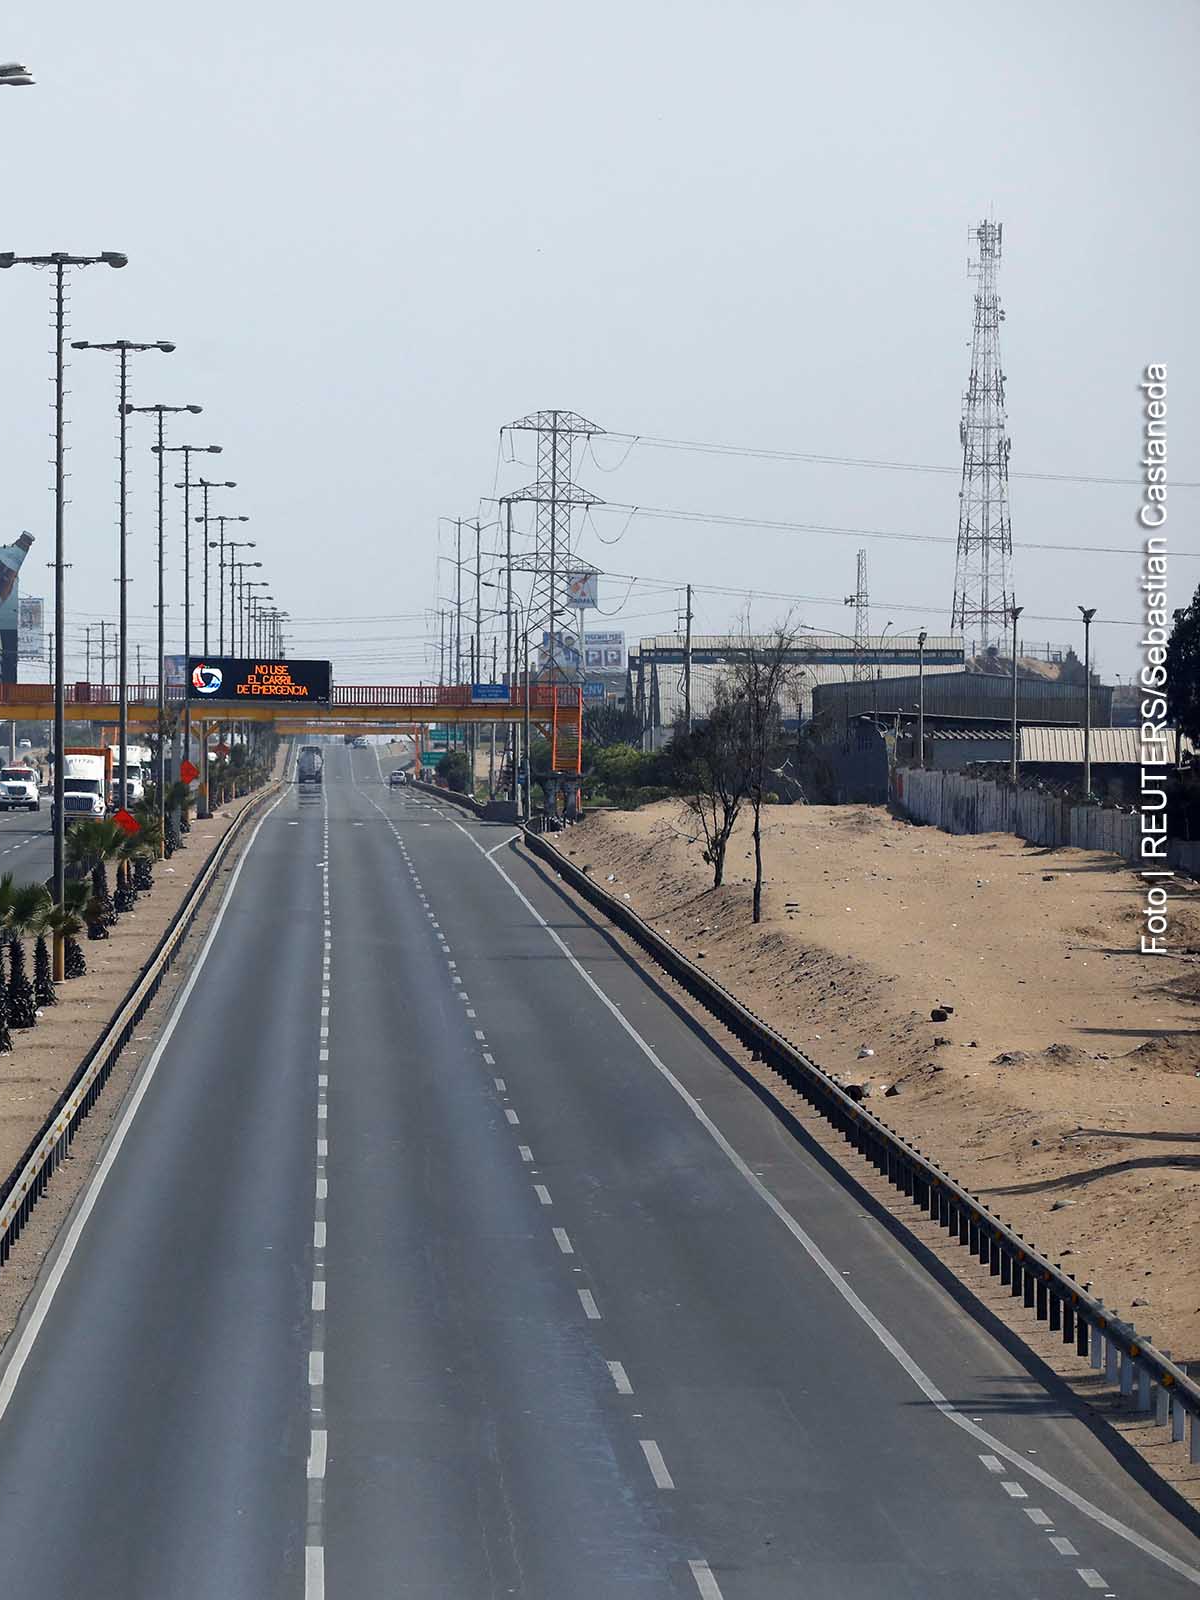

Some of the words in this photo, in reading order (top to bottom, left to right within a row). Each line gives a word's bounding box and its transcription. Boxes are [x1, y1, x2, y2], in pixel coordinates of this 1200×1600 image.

[254, 664, 269, 675] NO
[270, 665, 289, 675] USE
[247, 674, 261, 685] EL
[262, 675, 295, 686] CARRIL
[235, 684, 249, 695] DE
[251, 684, 309, 696] EMERGENCIA
